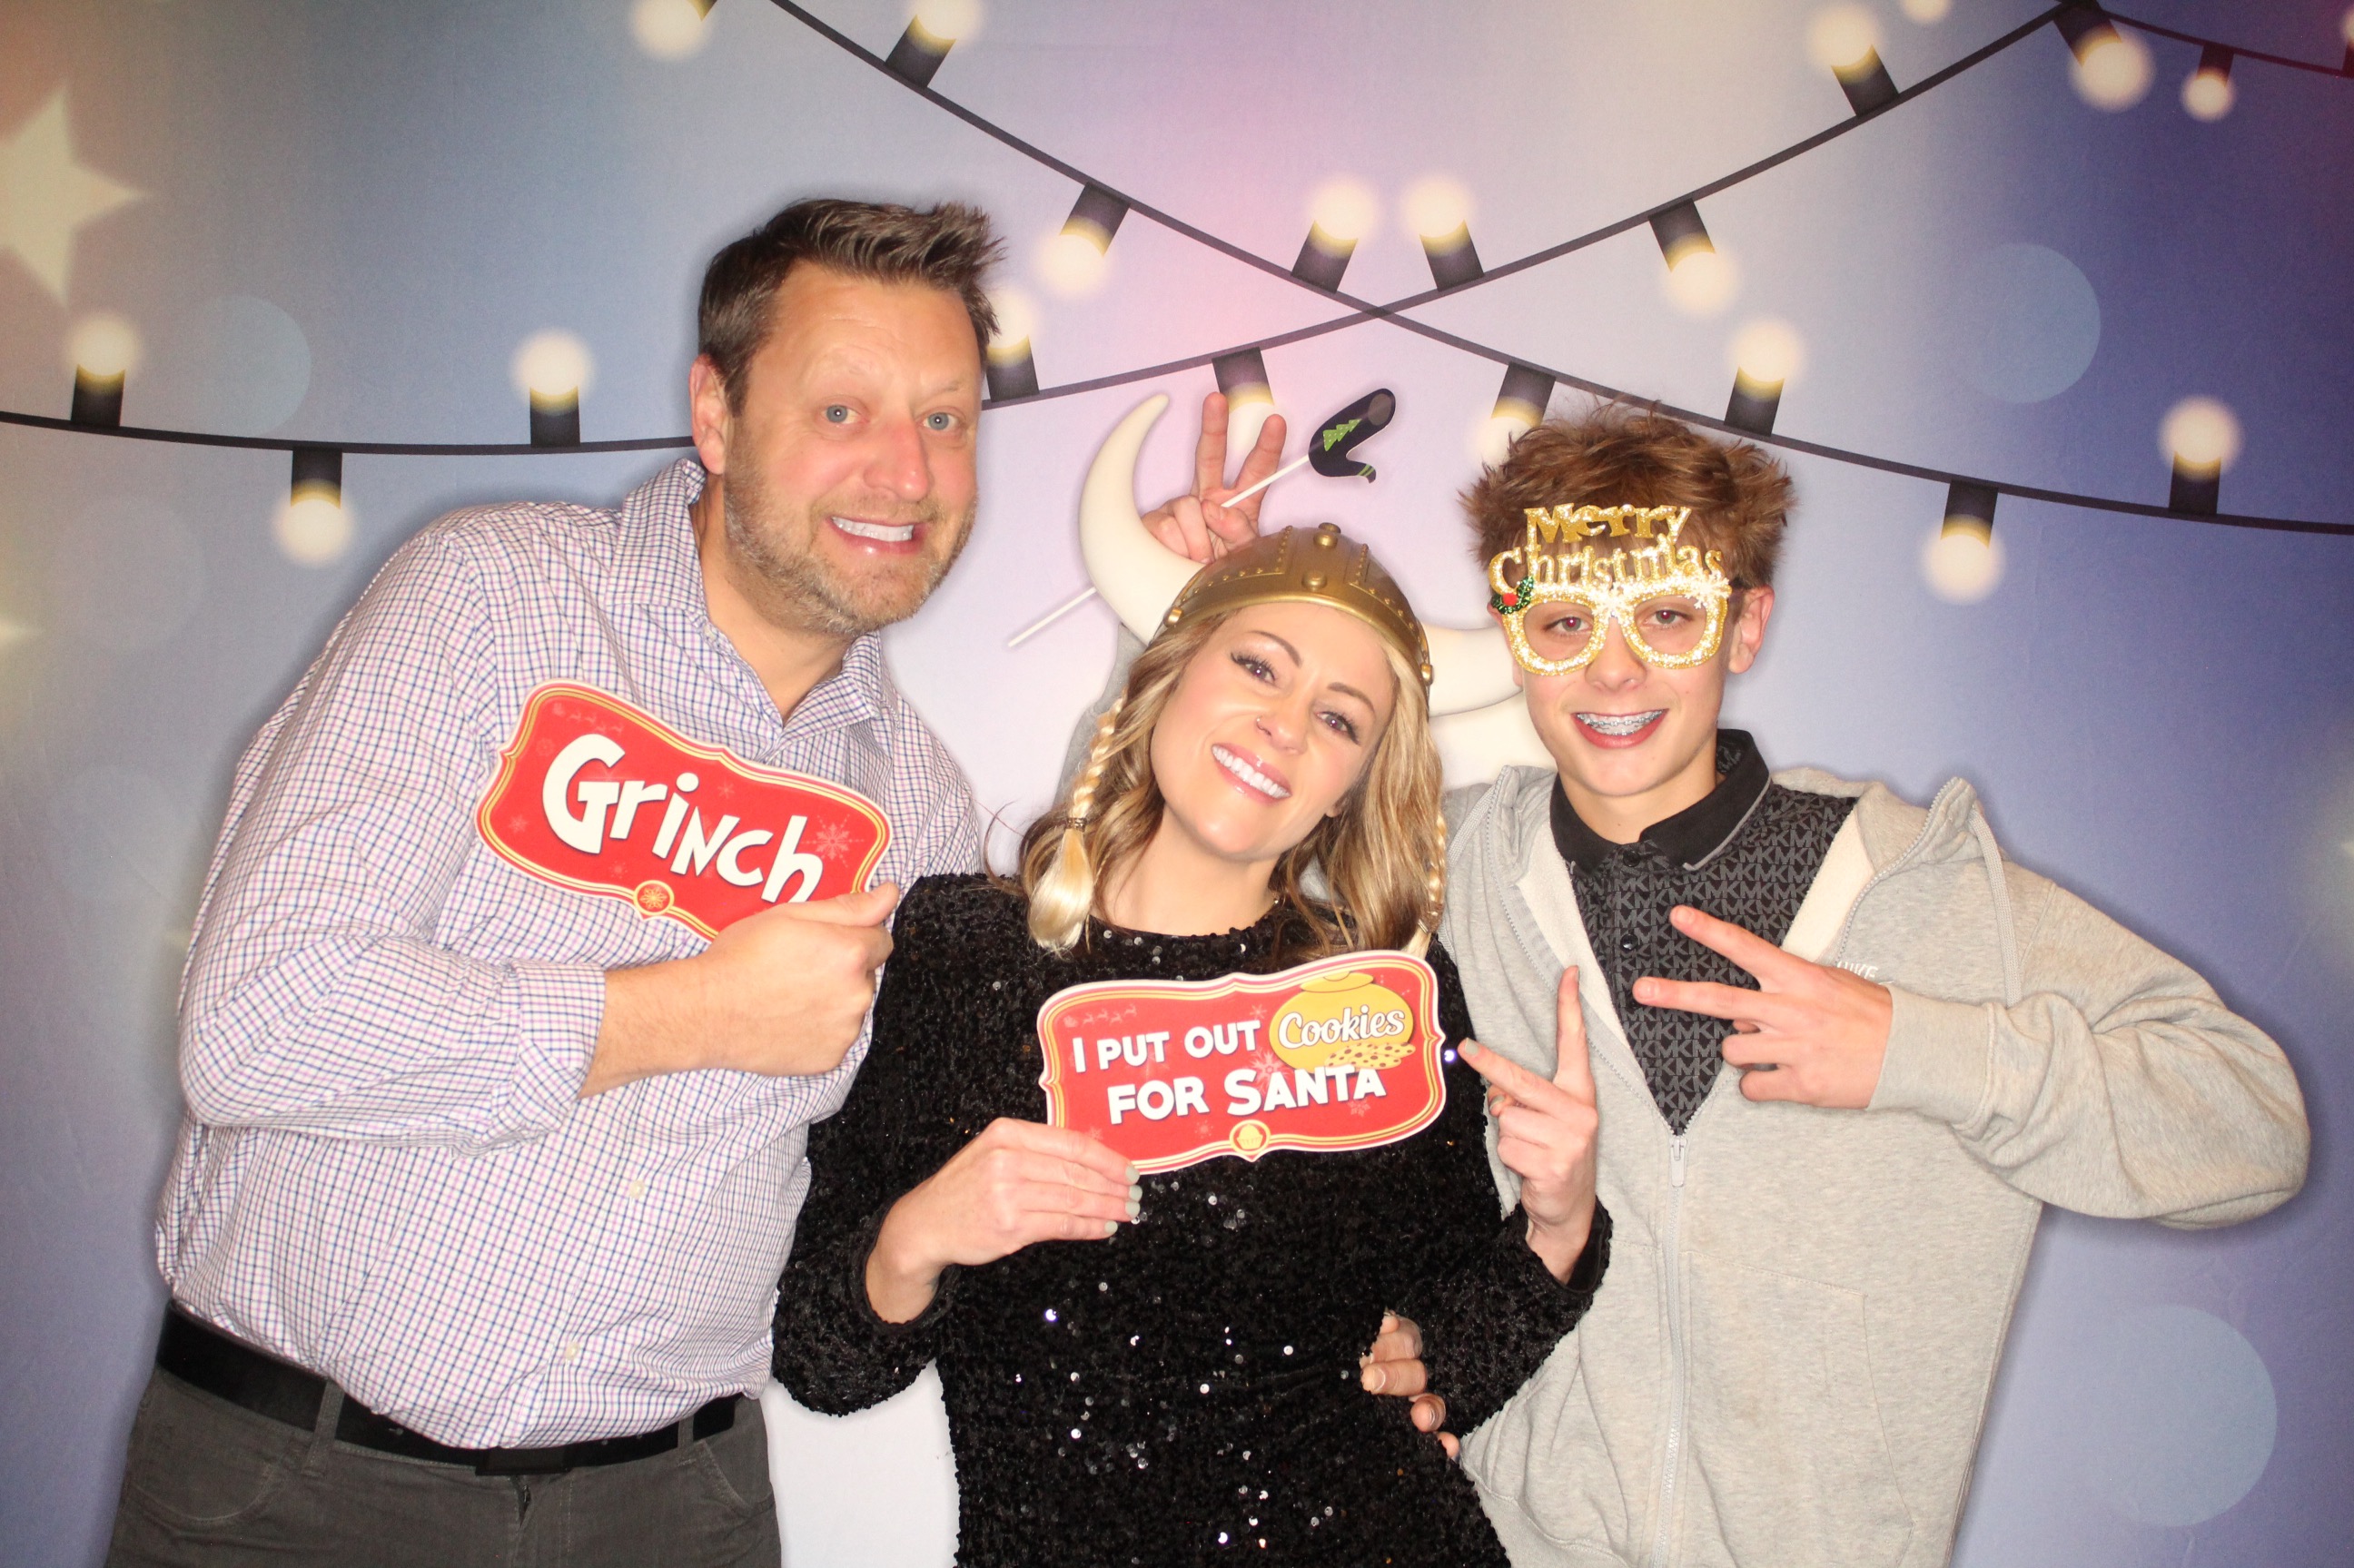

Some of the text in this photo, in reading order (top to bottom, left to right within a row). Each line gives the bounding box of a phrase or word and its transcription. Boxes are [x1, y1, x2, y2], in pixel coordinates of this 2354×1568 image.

[1524, 502, 1692, 547] Merry
[1489, 545, 1725, 595] Christmas
[1739, 846, 1775, 863] MK
[1775, 846, 1808, 865] MK
[1720, 862, 1756, 881] MK
[1756, 863, 1788, 883] MK
[1615, 873, 1650, 892] MK
[1635, 889, 1669, 909] MK
[1669, 883, 1706, 904] MK
[1706, 881, 1741, 900] MK
[1740, 881, 1774, 900] MK
[1722, 898, 1756, 916] MK
[1756, 899, 1793, 917] MK
[1615, 908, 1651, 928] MK
[1652, 939, 1689, 959] MK
[1636, 954, 1673, 970] MK
[1673, 953, 1711, 970] MK
[1073, 1005, 1405, 1072] I PUT OUT Cookies
[1639, 1021, 1676, 1040] MK
[1676, 1021, 1715, 1040] MK
[1656, 1040, 1692, 1058] MK
[1676, 1057, 1715, 1076] MK
[1656, 1075, 1694, 1092] MK
[1107, 1064, 1387, 1124] FOR SANTA
